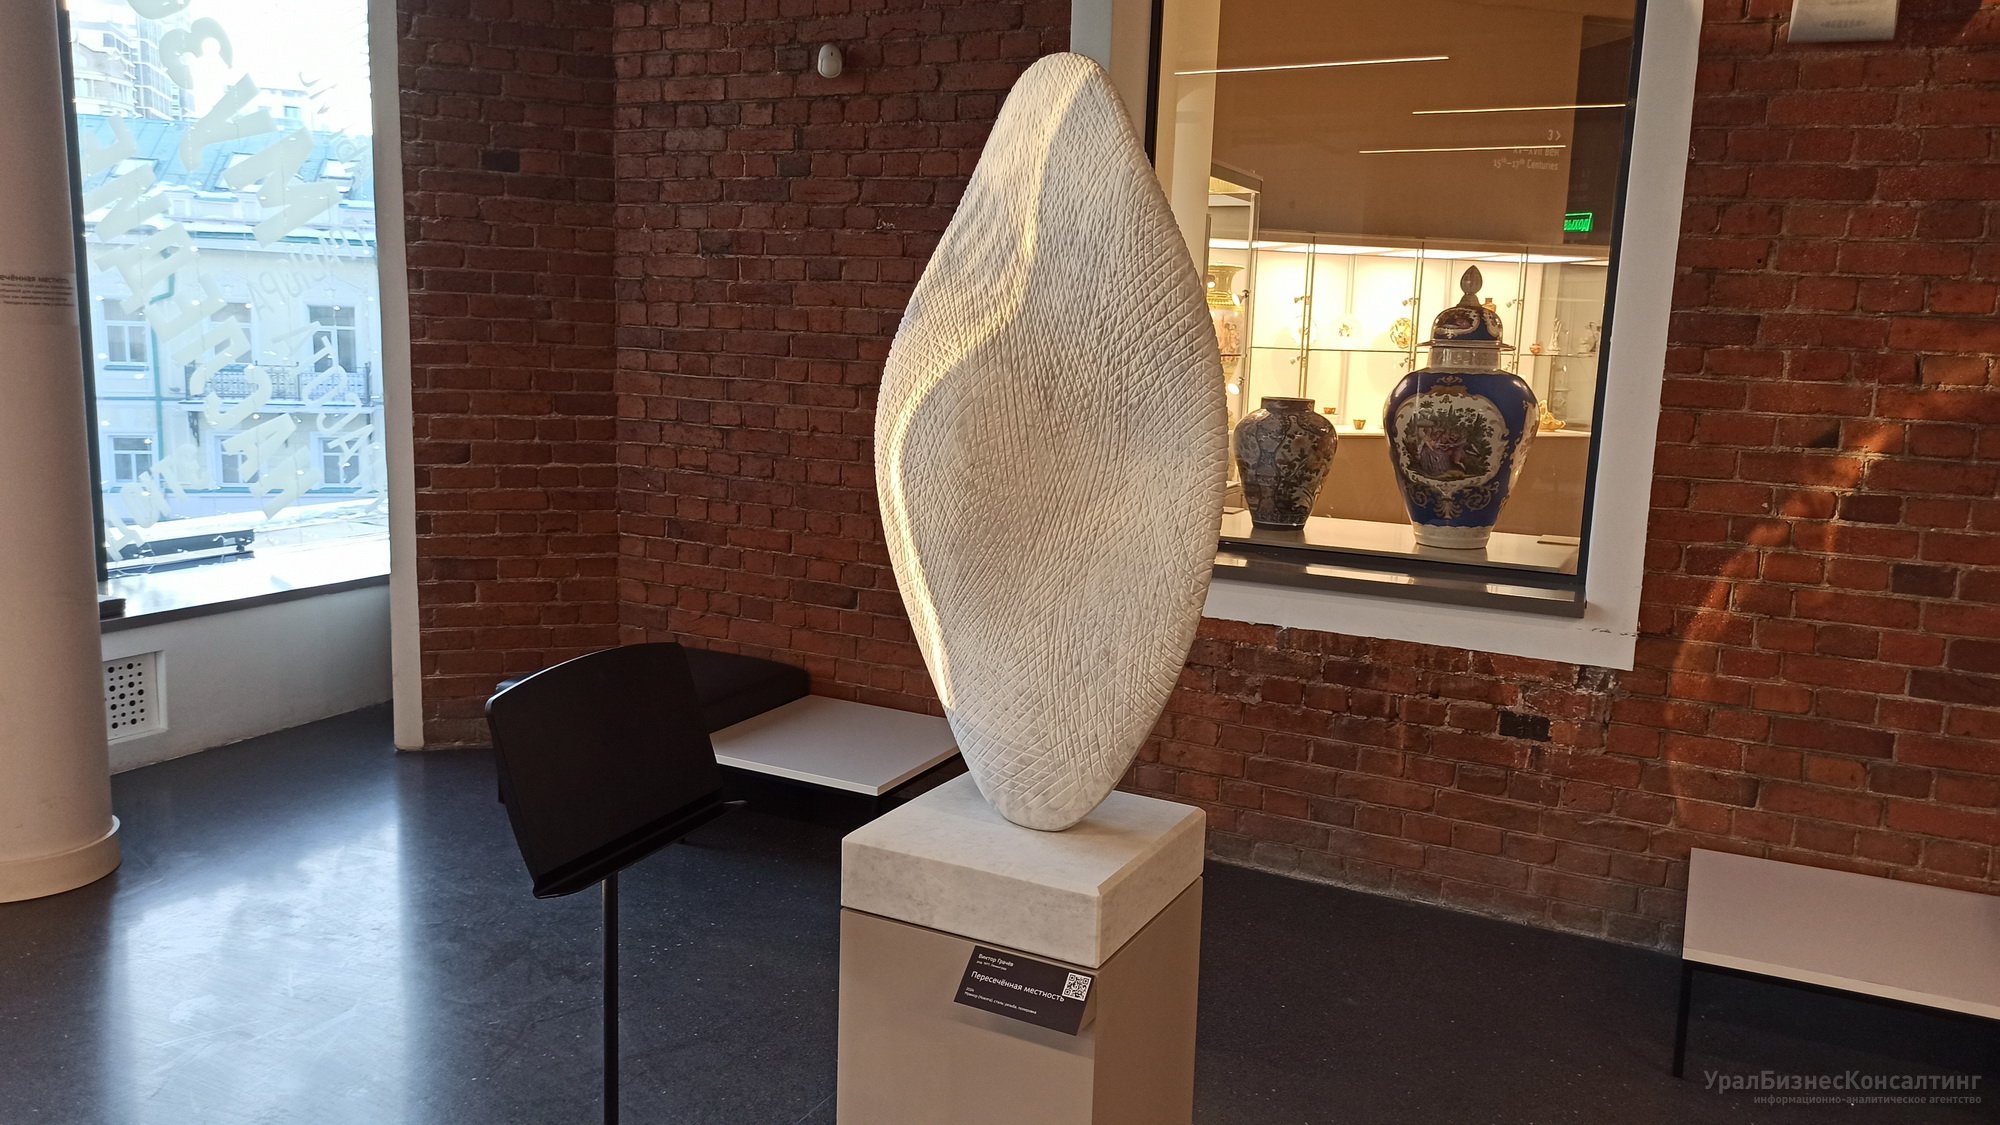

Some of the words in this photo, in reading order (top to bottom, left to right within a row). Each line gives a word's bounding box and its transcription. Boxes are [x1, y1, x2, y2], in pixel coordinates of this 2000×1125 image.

[978, 953, 997, 964] Виктор
[971, 970, 1022, 991] Пересечённая
[1023, 986, 1065, 1002] местность
